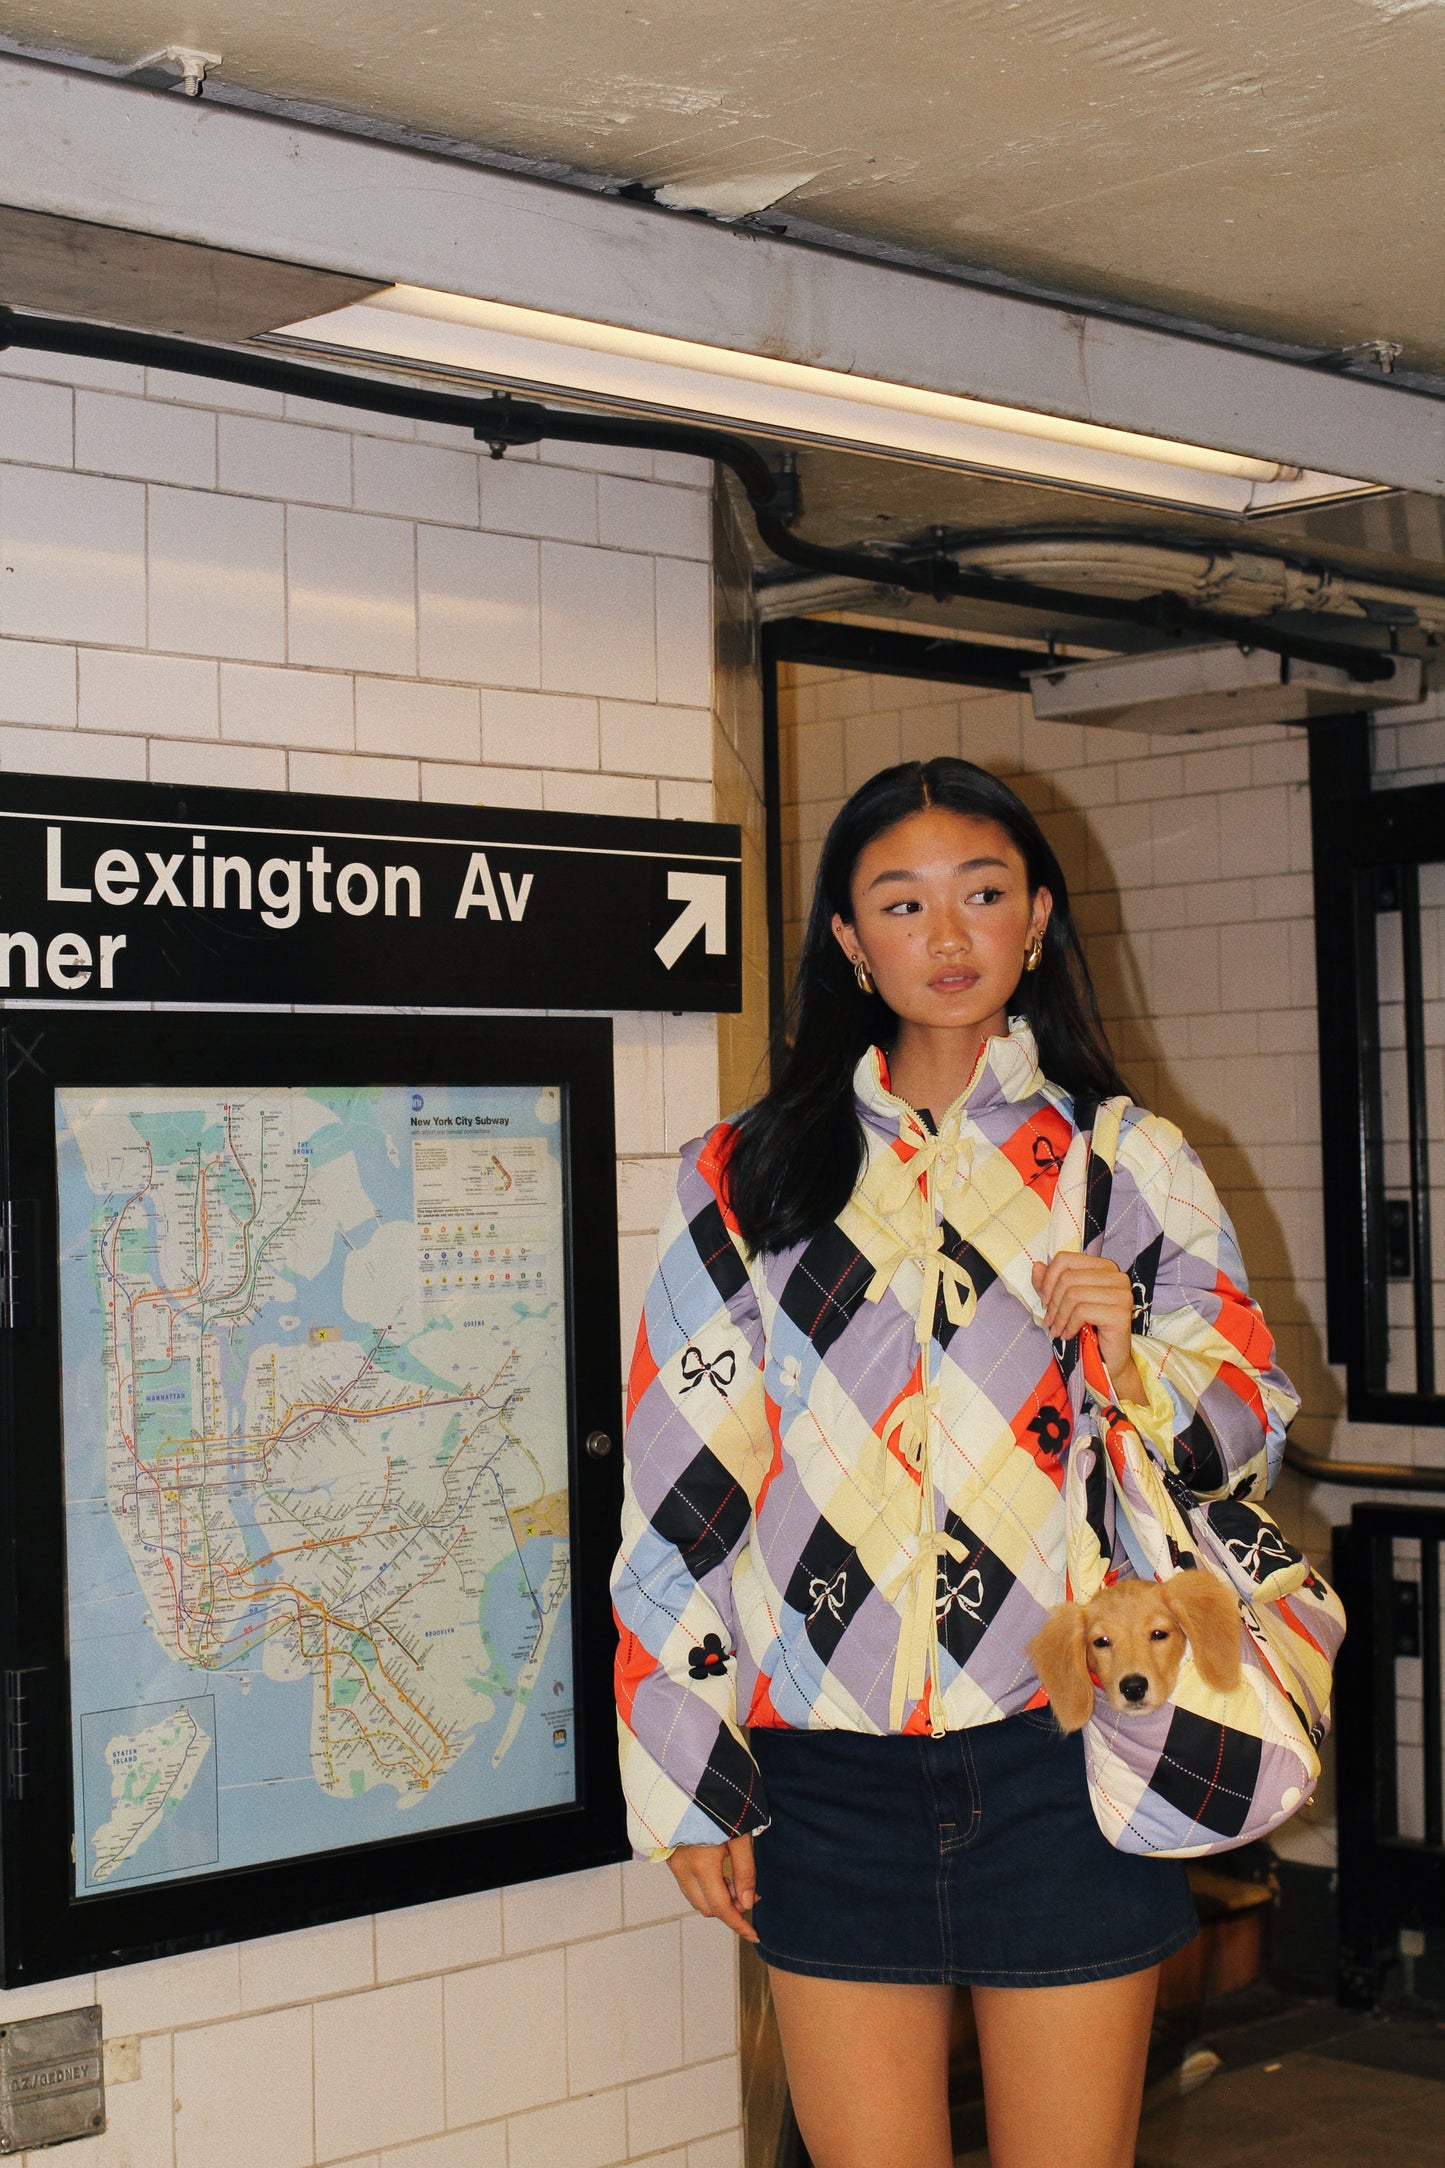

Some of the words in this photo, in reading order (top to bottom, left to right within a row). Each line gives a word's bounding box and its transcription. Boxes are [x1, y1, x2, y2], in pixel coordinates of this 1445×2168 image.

[46, 826, 422, 929] Lexington
[454, 852, 535, 922] Av
[0, 931, 127, 990] ner
[410, 1117, 431, 1126] New
[433, 1117, 453, 1126] York
[455, 1116, 473, 1127] City
[475, 1116, 510, 1127] Subway
[112, 1749, 137, 1757] STATEN
[113, 1756, 138, 1764] ISLAND
